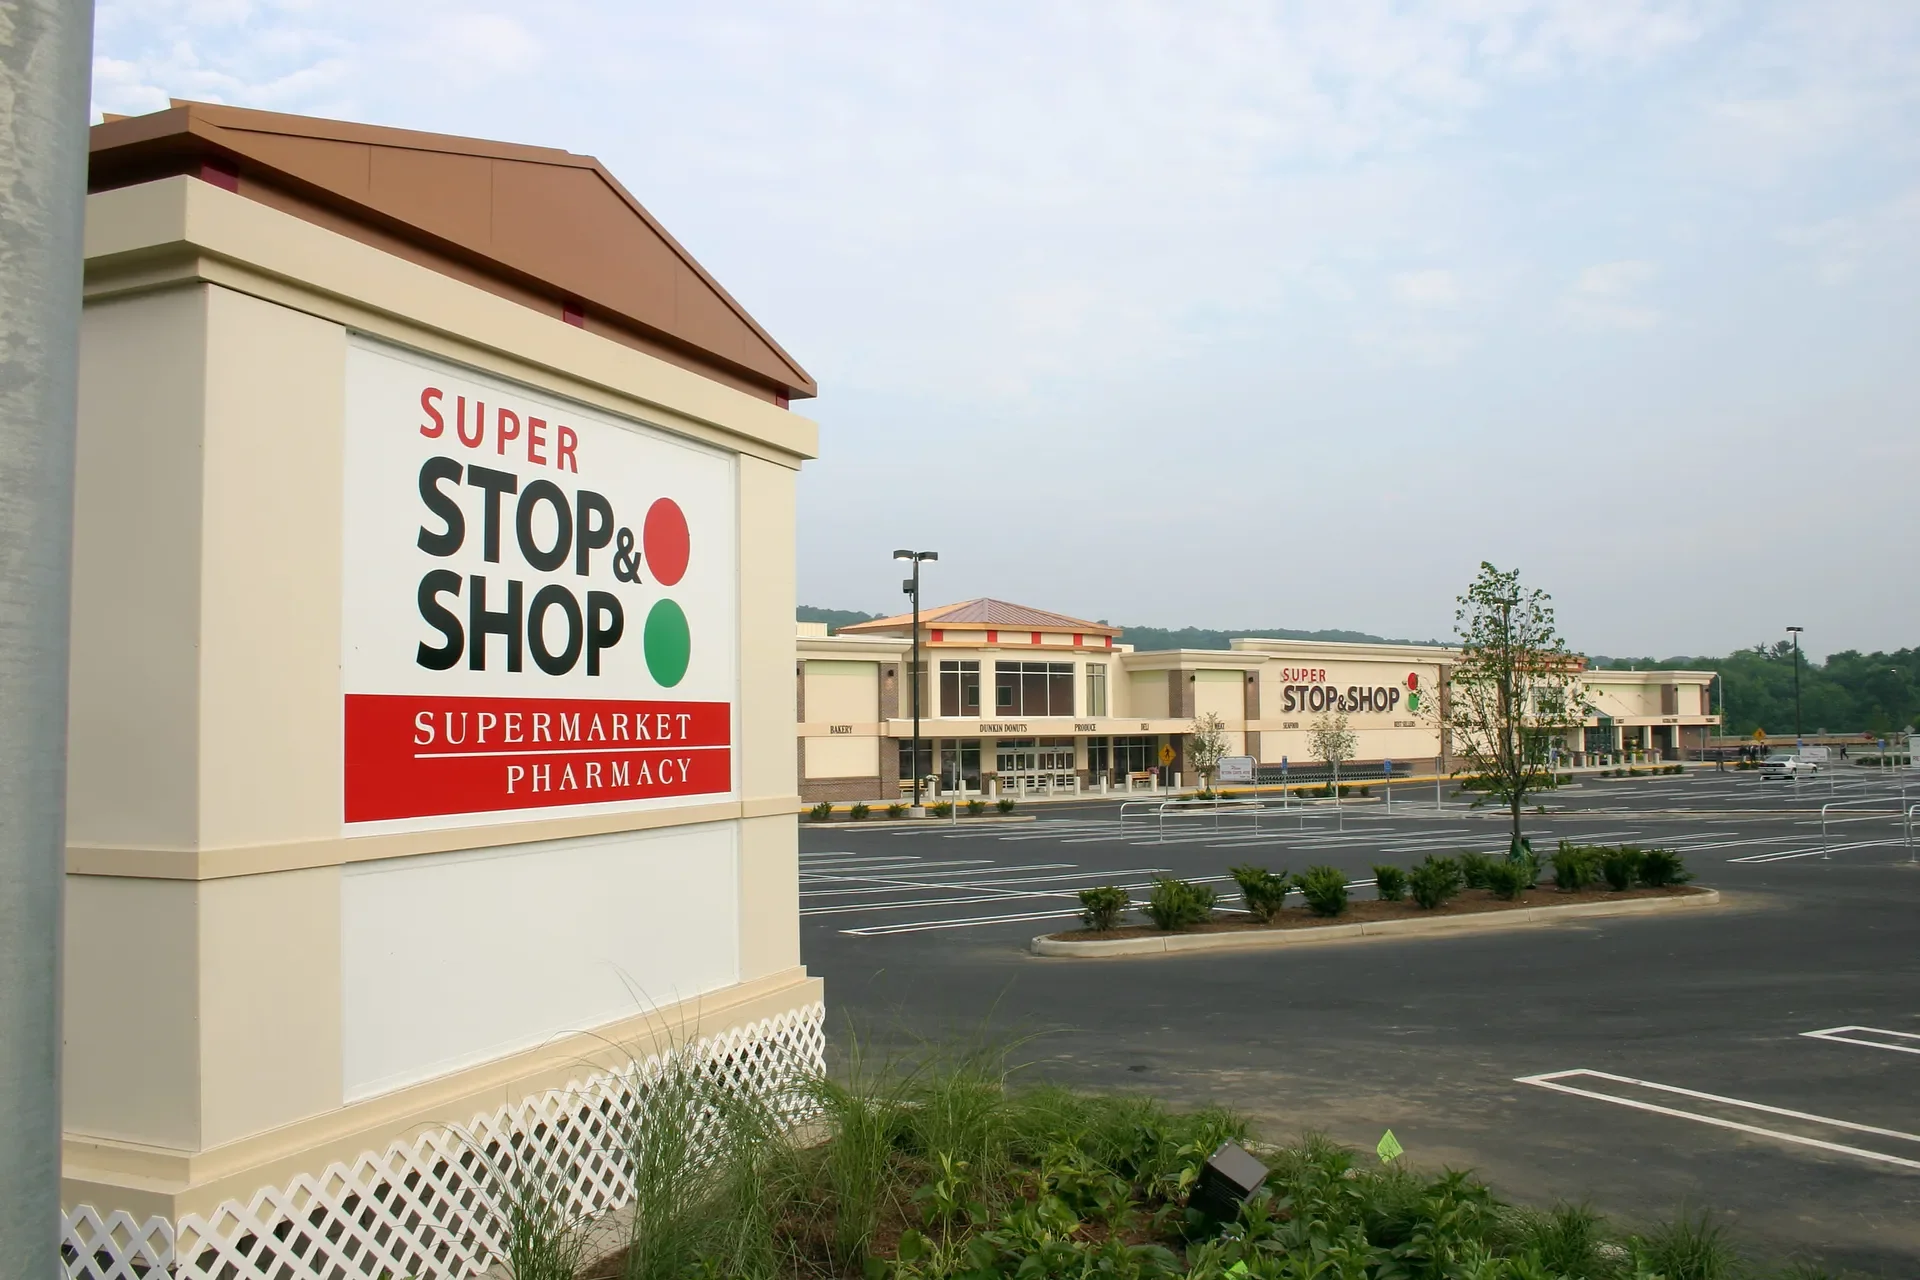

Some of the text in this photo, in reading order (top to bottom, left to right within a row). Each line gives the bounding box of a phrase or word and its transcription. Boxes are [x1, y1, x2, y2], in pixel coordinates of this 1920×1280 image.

[419, 387, 579, 474] SUPER
[415, 568, 625, 677] SHOP
[1282, 668, 1327, 682] SUPER
[414, 711, 693, 745] SUPERMARKET
[830, 725, 853, 734] BAKERY
[979, 724, 1028, 732] DUNKIN DONUTS
[1074, 723, 1097, 732] PRODUCE
[506, 758, 692, 794] PHARMACY
